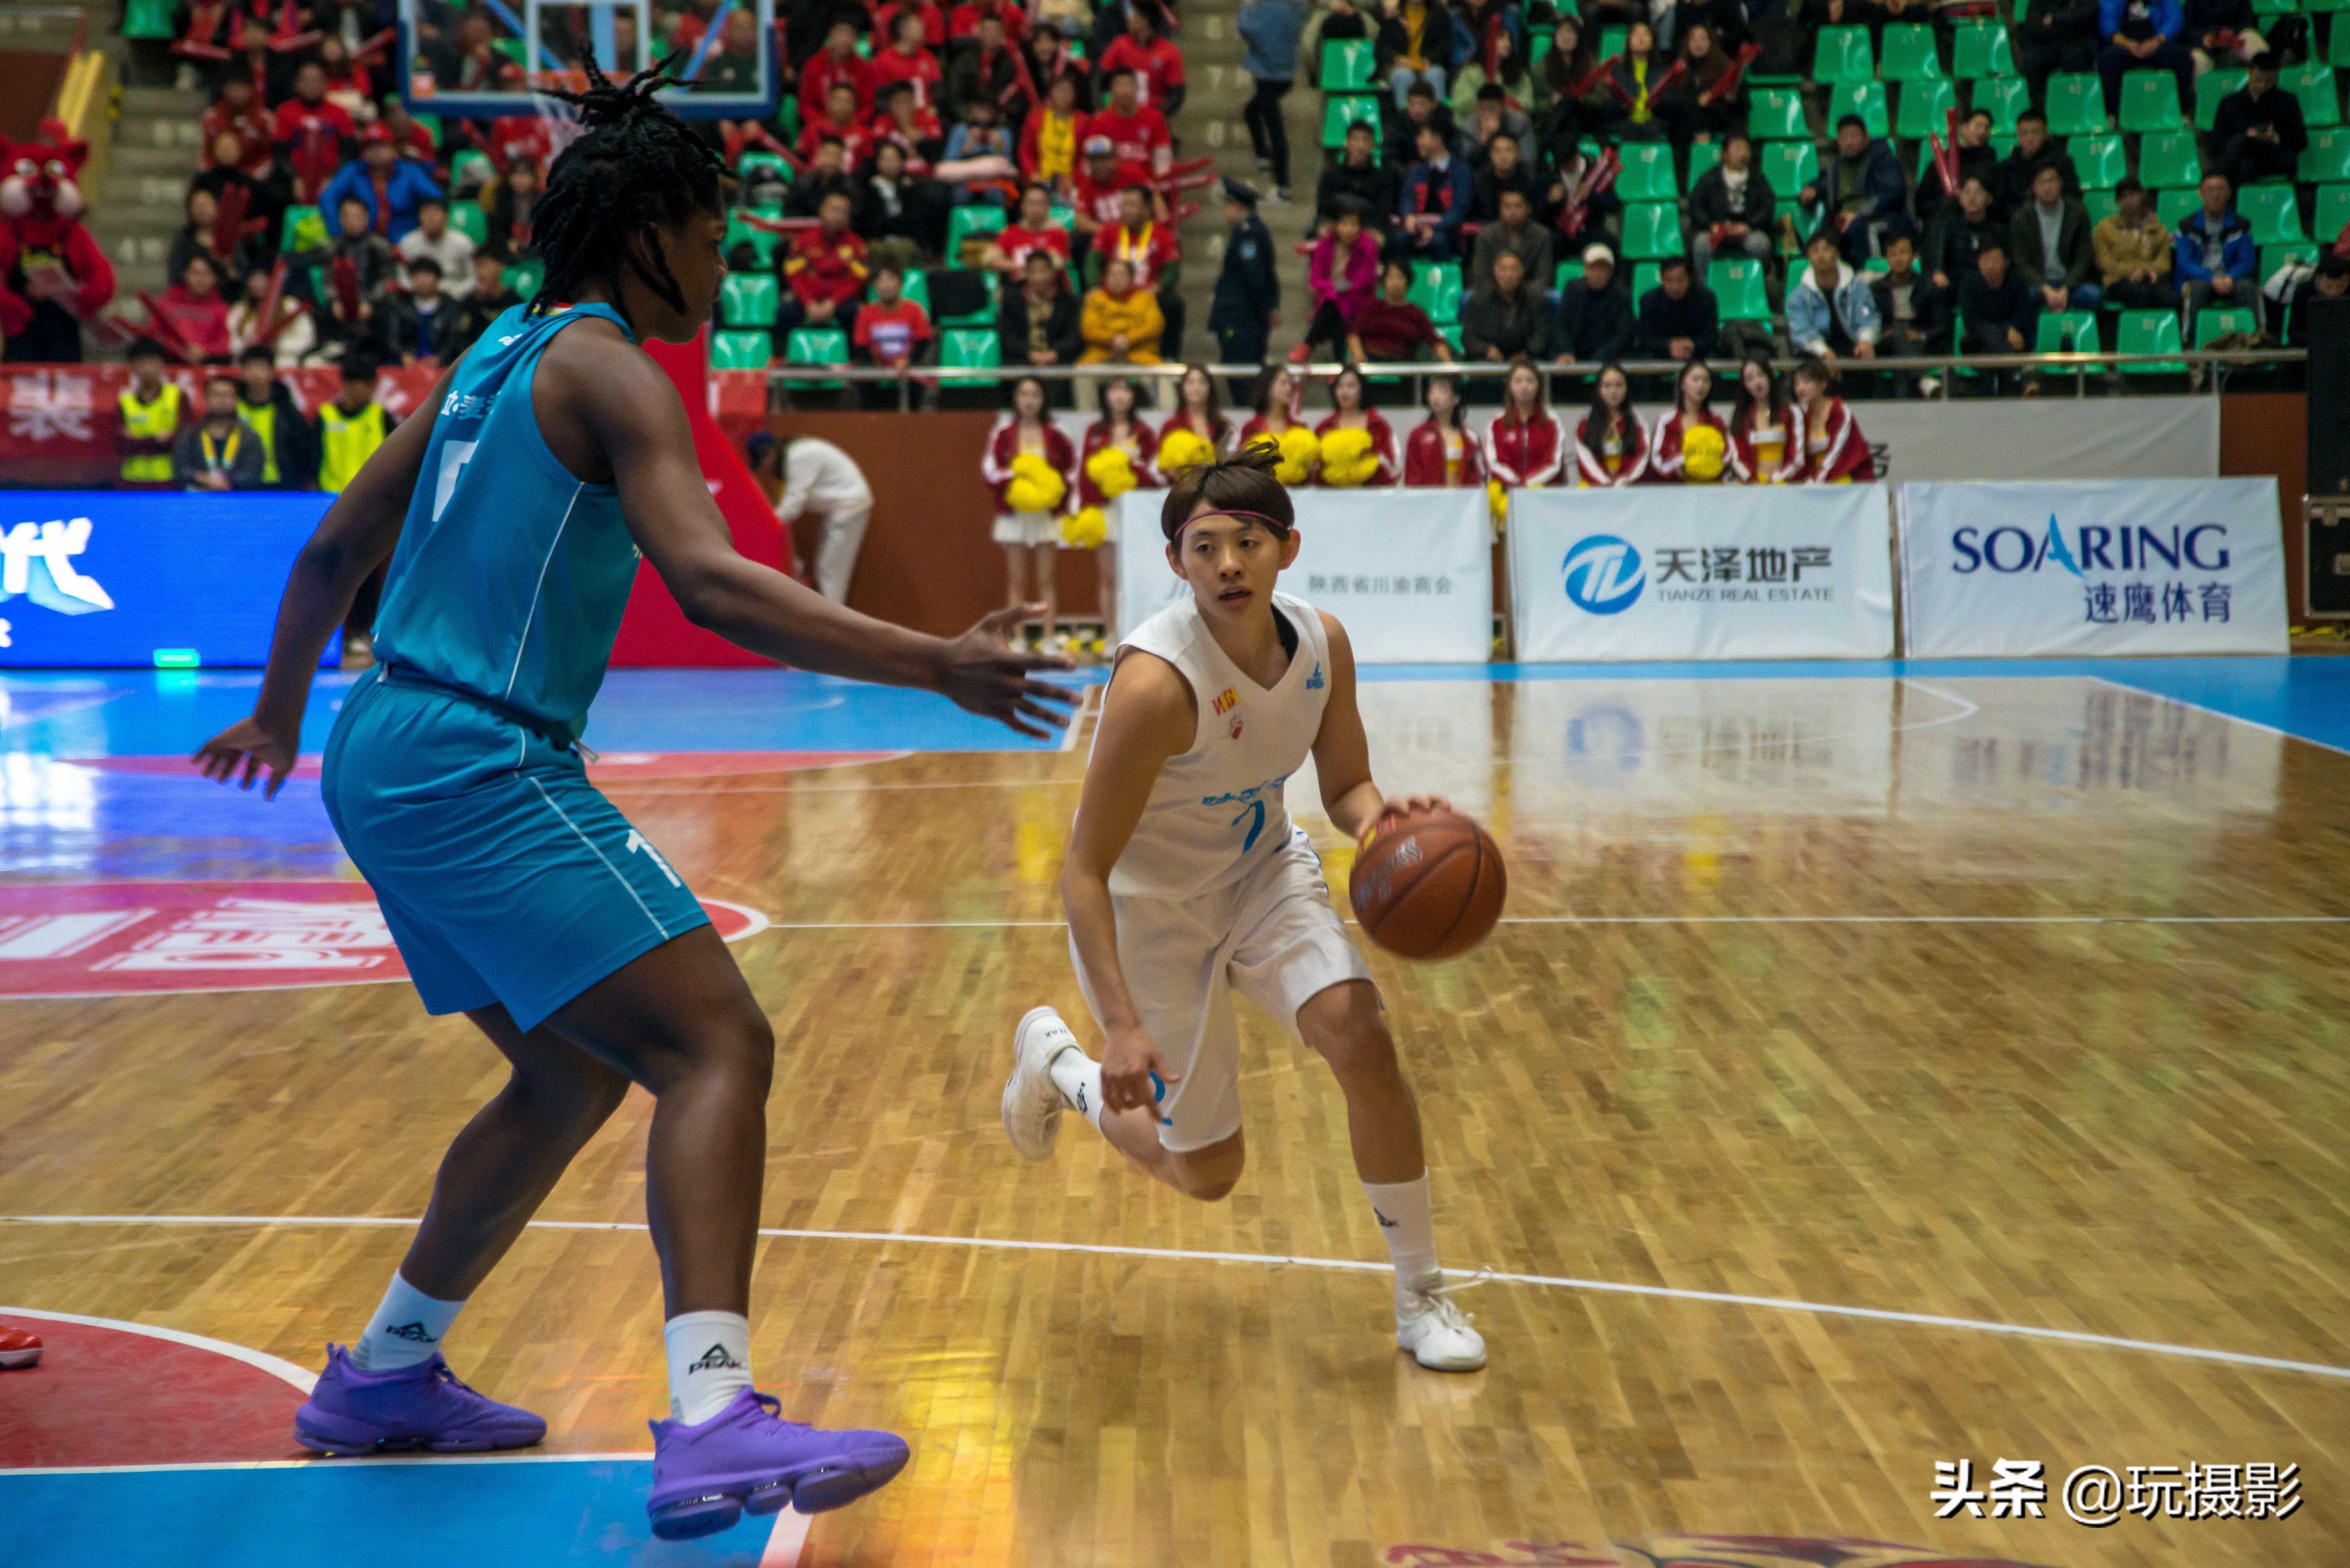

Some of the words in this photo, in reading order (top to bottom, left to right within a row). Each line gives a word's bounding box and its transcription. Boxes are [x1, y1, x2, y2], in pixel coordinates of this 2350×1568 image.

[1655, 546, 1832, 584] 天泽地产
[1952, 513, 2231, 578] SOARING
[1657, 588, 1712, 602] TIANZE
[1720, 588, 1761, 602] REAL
[1768, 588, 1833, 602] ESTATE
[2084, 581, 2232, 625] 速鹰体育
[1231, 799, 1265, 853] 7
